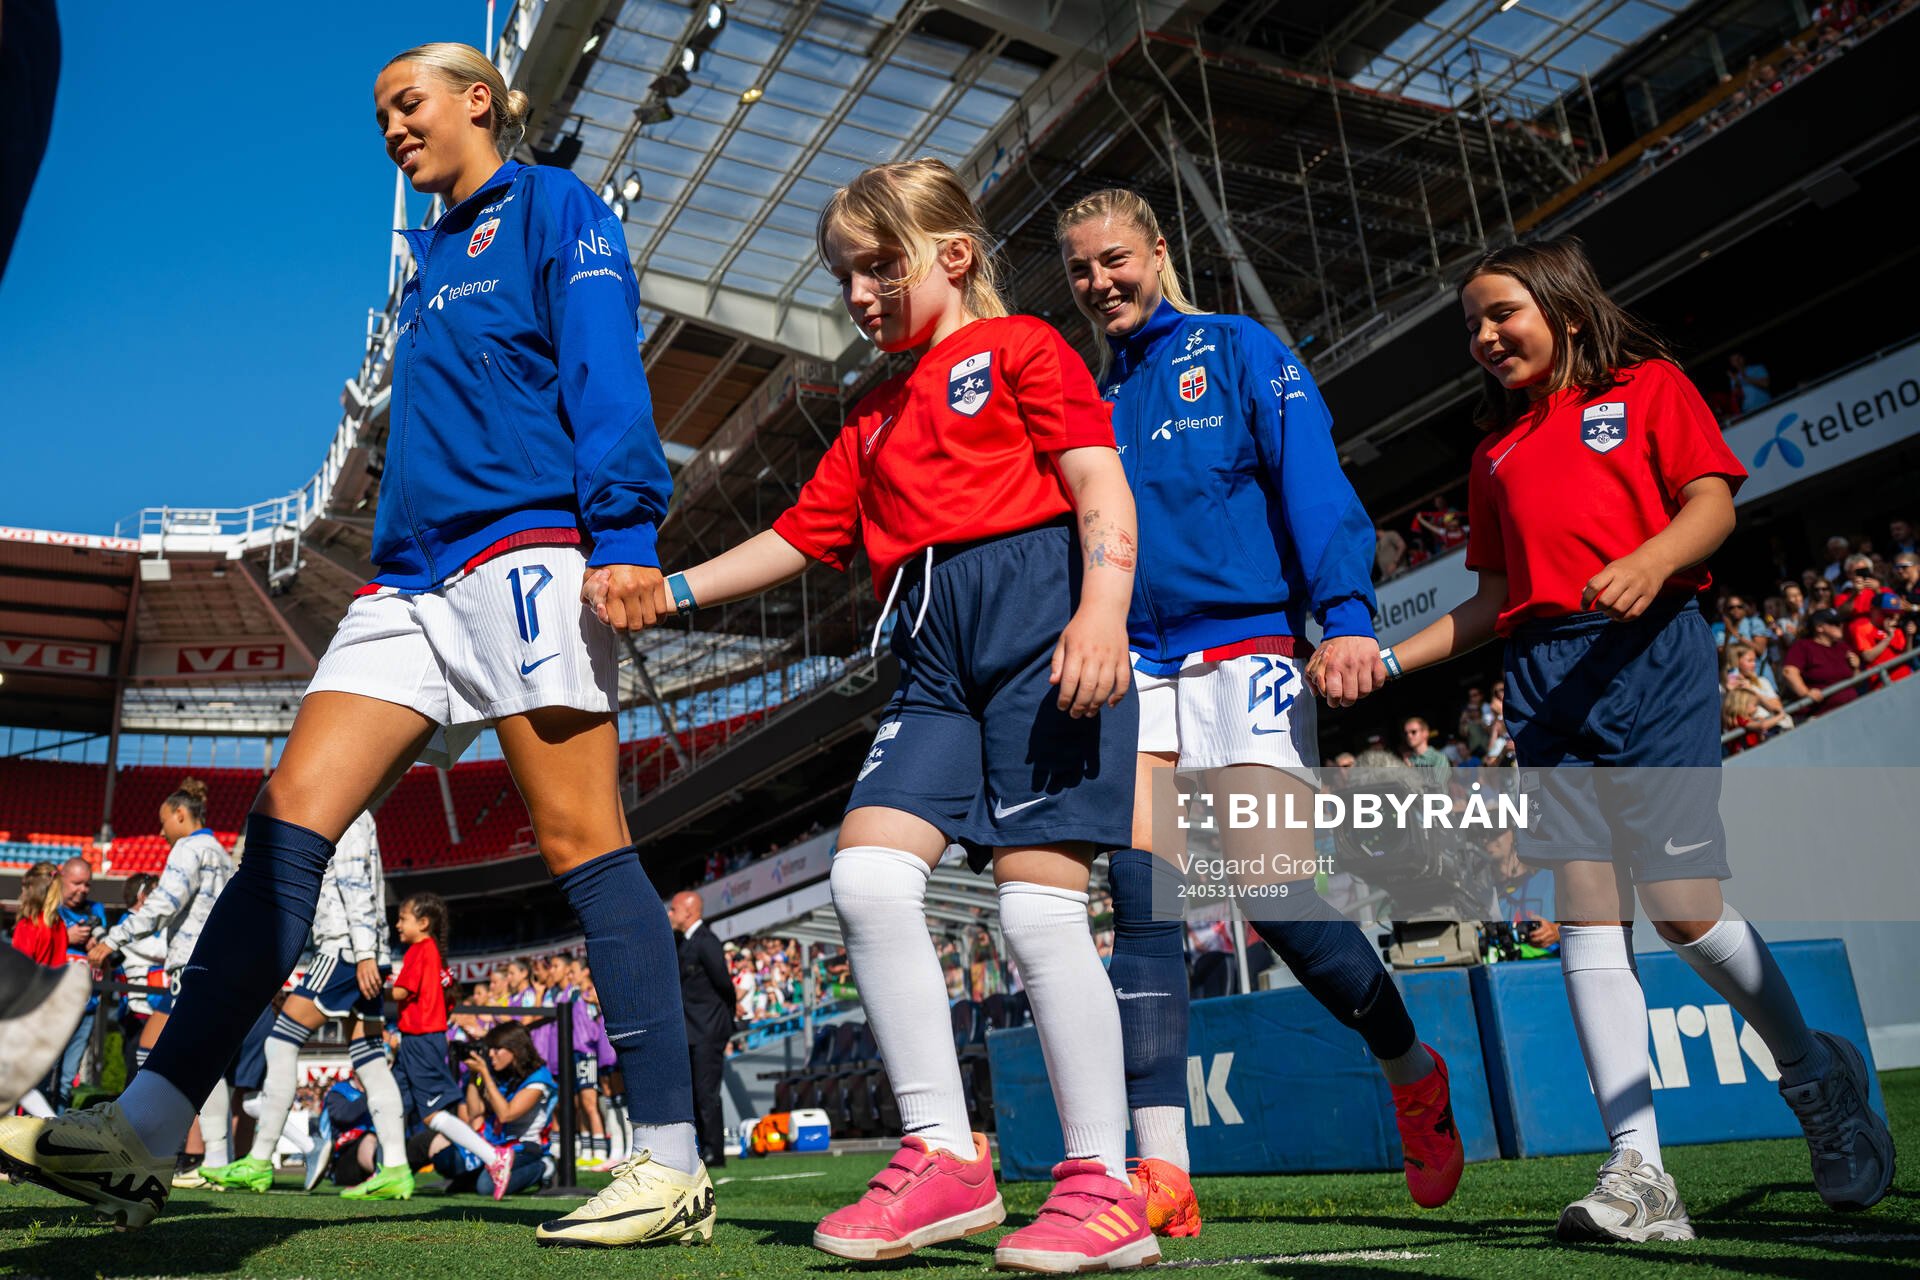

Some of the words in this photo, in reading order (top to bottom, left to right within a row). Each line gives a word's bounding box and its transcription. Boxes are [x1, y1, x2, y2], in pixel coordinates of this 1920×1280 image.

[573, 228, 612, 264] NB
[448, 277, 499, 301] telenor
[1171, 353, 1192, 366] Norsk
[1191, 344, 1216, 358] Tipping
[1174, 415, 1224, 432] telenor
[506, 564, 554, 645] 17
[0, 642, 90, 672] VG
[181, 646, 282, 671] VG
[1248, 655, 1295, 717] 22
